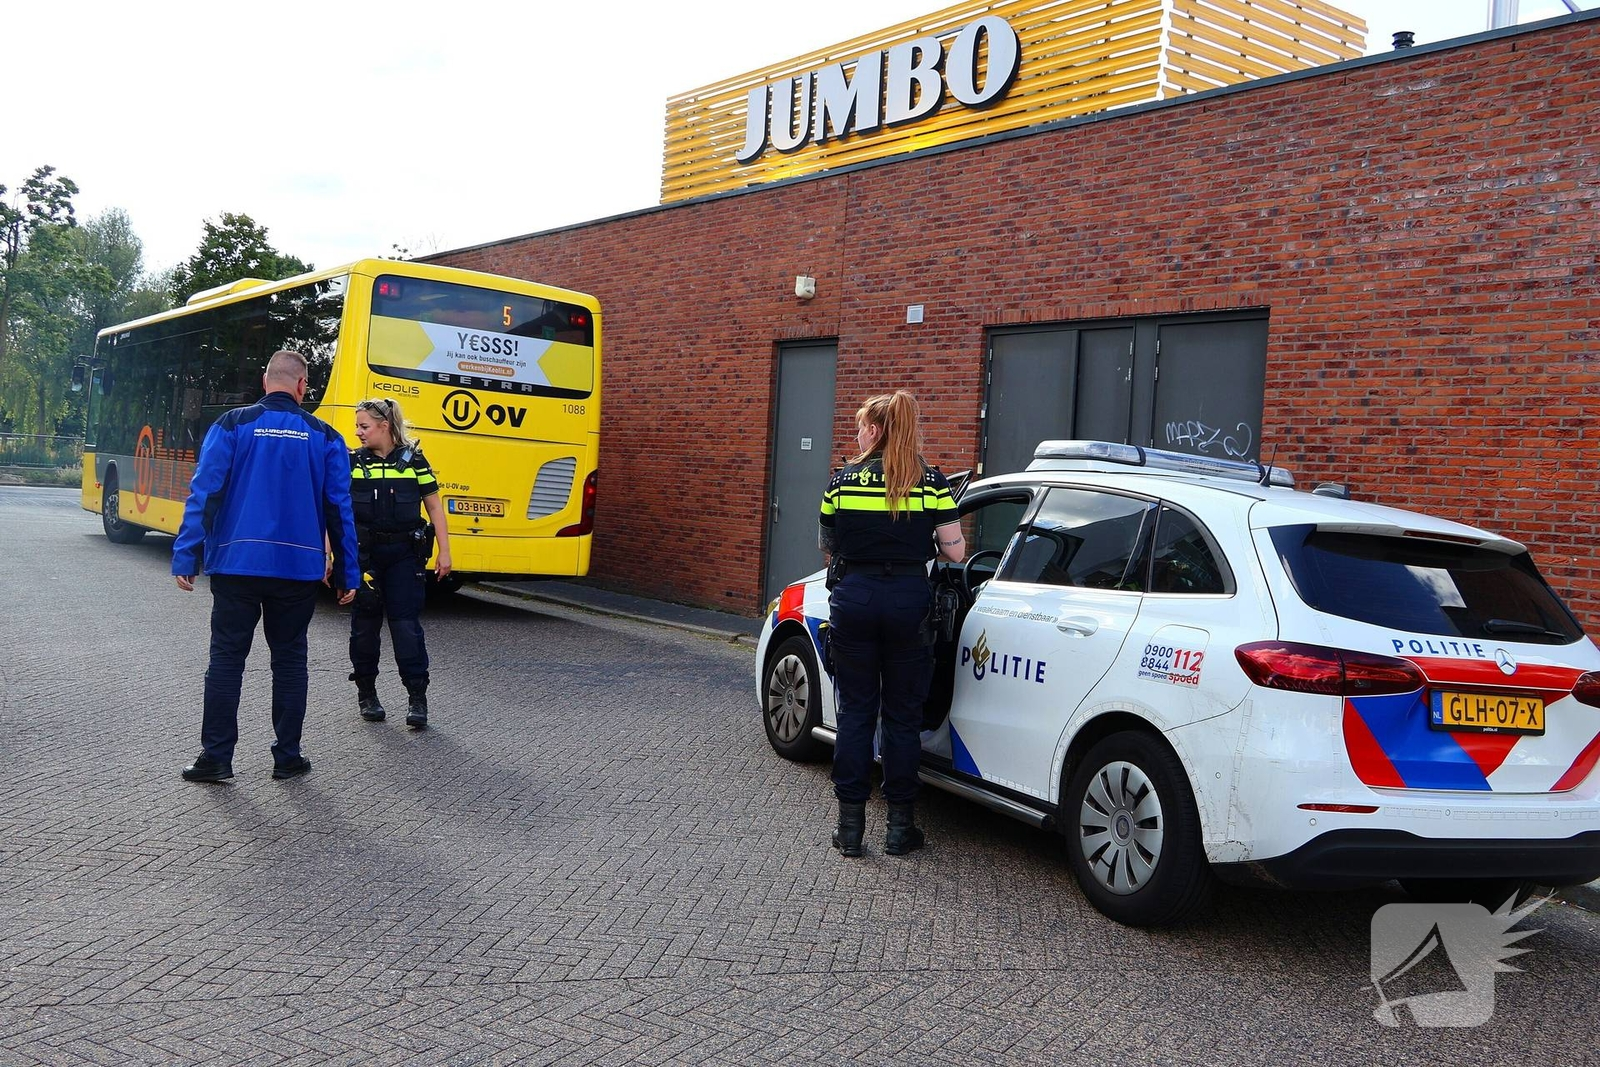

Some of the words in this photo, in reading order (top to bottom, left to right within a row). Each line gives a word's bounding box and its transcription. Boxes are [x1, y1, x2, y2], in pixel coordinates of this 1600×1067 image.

[735, 15, 1021, 164] JUMBO
[502, 305, 513, 327] 5
[467, 353, 477, 361] ook
[479, 355, 515, 366] buschauffeur
[516, 360, 527, 369] zijn
[437, 372, 533, 393] SETRA
[485, 404, 527, 428] OV
[562, 404, 586, 416] 1088
[457, 502, 501, 514] 03-BHX-3
[976, 606, 1009, 616] waakzaam
[1009, 610, 1018, 618] en
[1018, 612, 1054, 623] dienstbaar
[1145, 644, 1173, 658] 0900
[1391, 639, 1486, 658] POLITIE
[961, 646, 1046, 683] POLITIE
[1141, 657, 1169, 671] 8844
[1174, 649, 1204, 672] 112
[1151, 672, 1167, 680] spoed
[1168, 673, 1199, 685] spoed
[1432, 711, 1442, 720] NL
[1450, 697, 1538, 726] GLH-07-X
